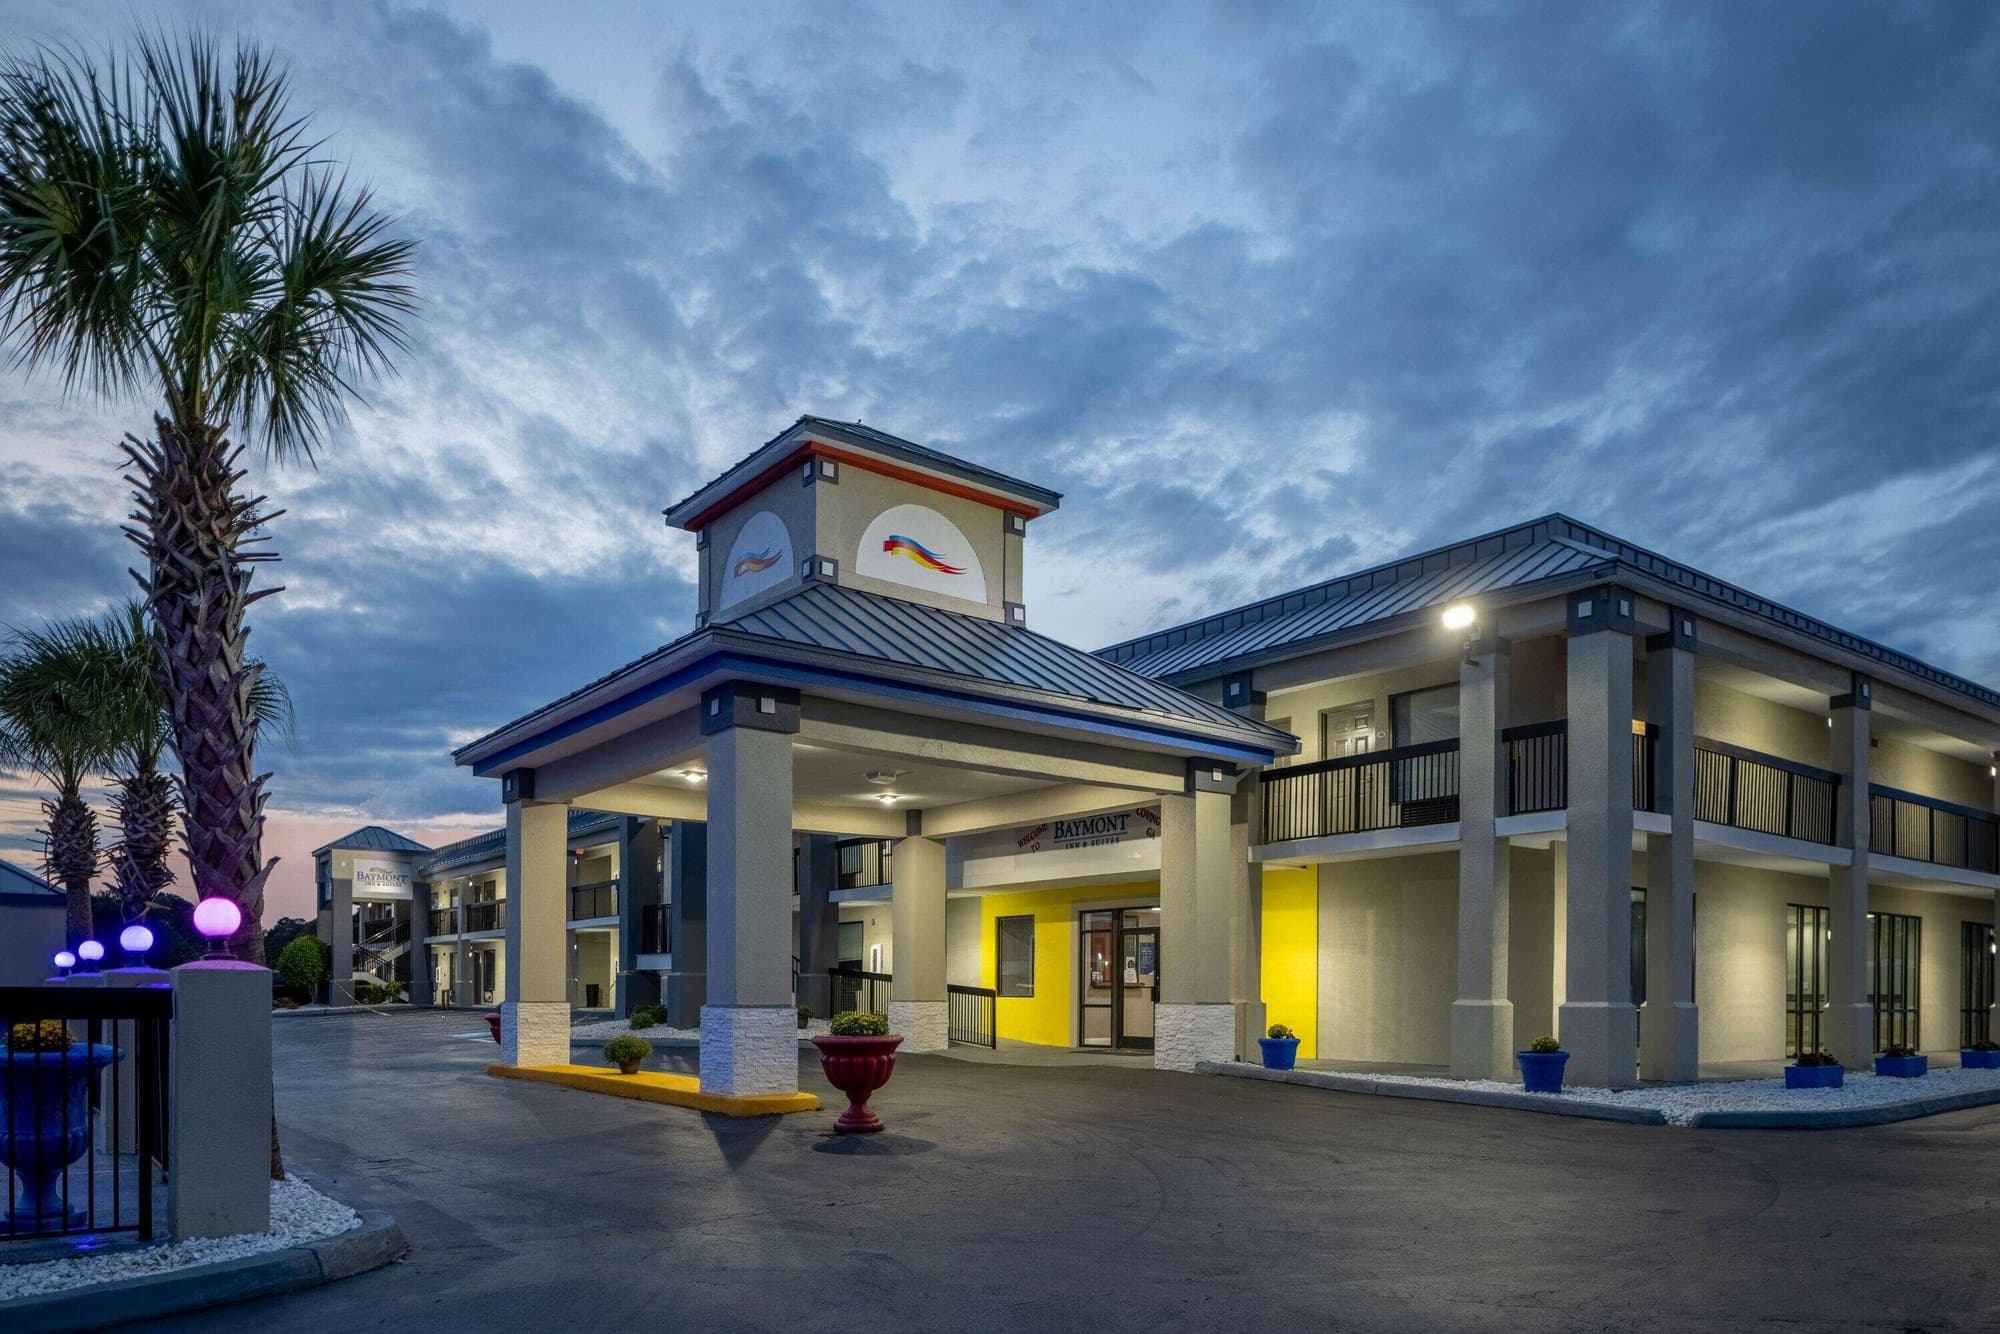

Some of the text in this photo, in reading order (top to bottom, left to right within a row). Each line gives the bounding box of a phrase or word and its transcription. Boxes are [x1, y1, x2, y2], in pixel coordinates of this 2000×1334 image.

[1054, 814, 1131, 840] BAYMONT
[1017, 823, 1048, 848] WELCOME
[1146, 827, 1155, 840] GA
[1031, 841, 1041, 853] TO
[1065, 840, 1080, 849] INN
[1091, 837, 1120, 847] SUITES
[357, 871, 408, 882] BAYMONT
